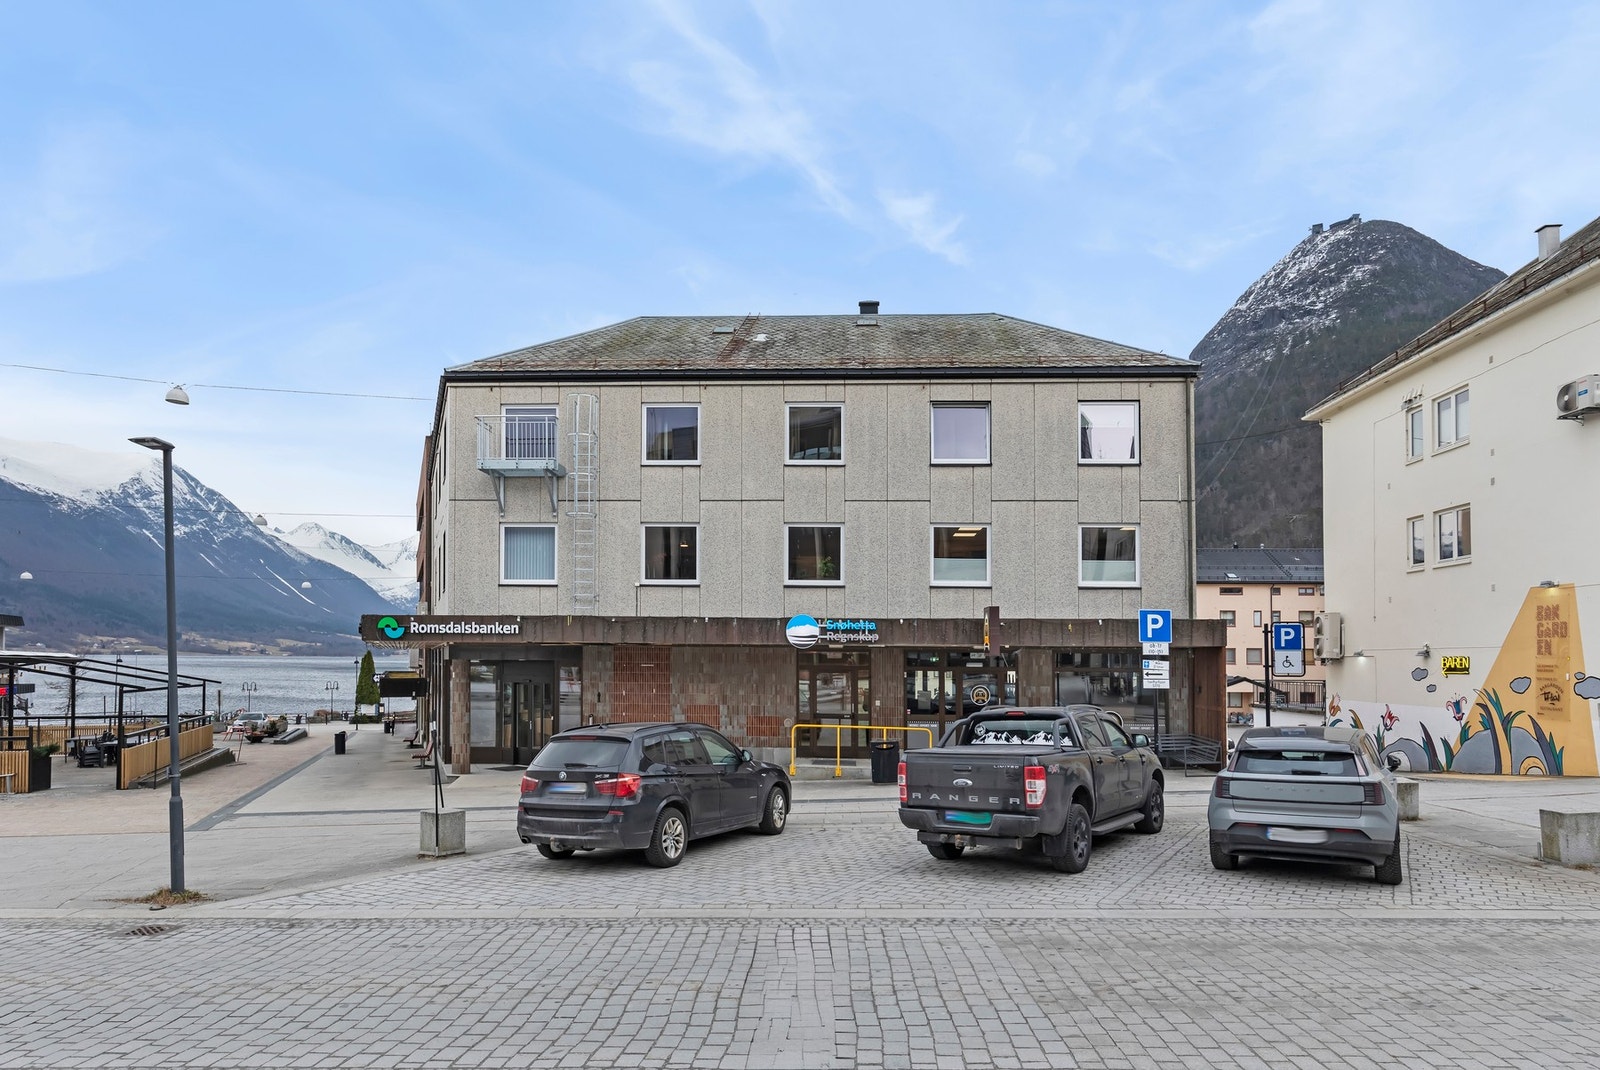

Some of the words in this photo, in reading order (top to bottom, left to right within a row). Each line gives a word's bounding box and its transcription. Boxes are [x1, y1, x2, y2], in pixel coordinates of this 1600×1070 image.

[410, 621, 519, 634] Romsdalsbanken
[826, 620, 877, 630] Snøhetta
[1147, 614, 1164, 638] P
[826, 631, 879, 643] Regnskap
[1280, 627, 1295, 647] P
[1441, 656, 1470, 669] BAREN
[912, 792, 1020, 805] RANGER
